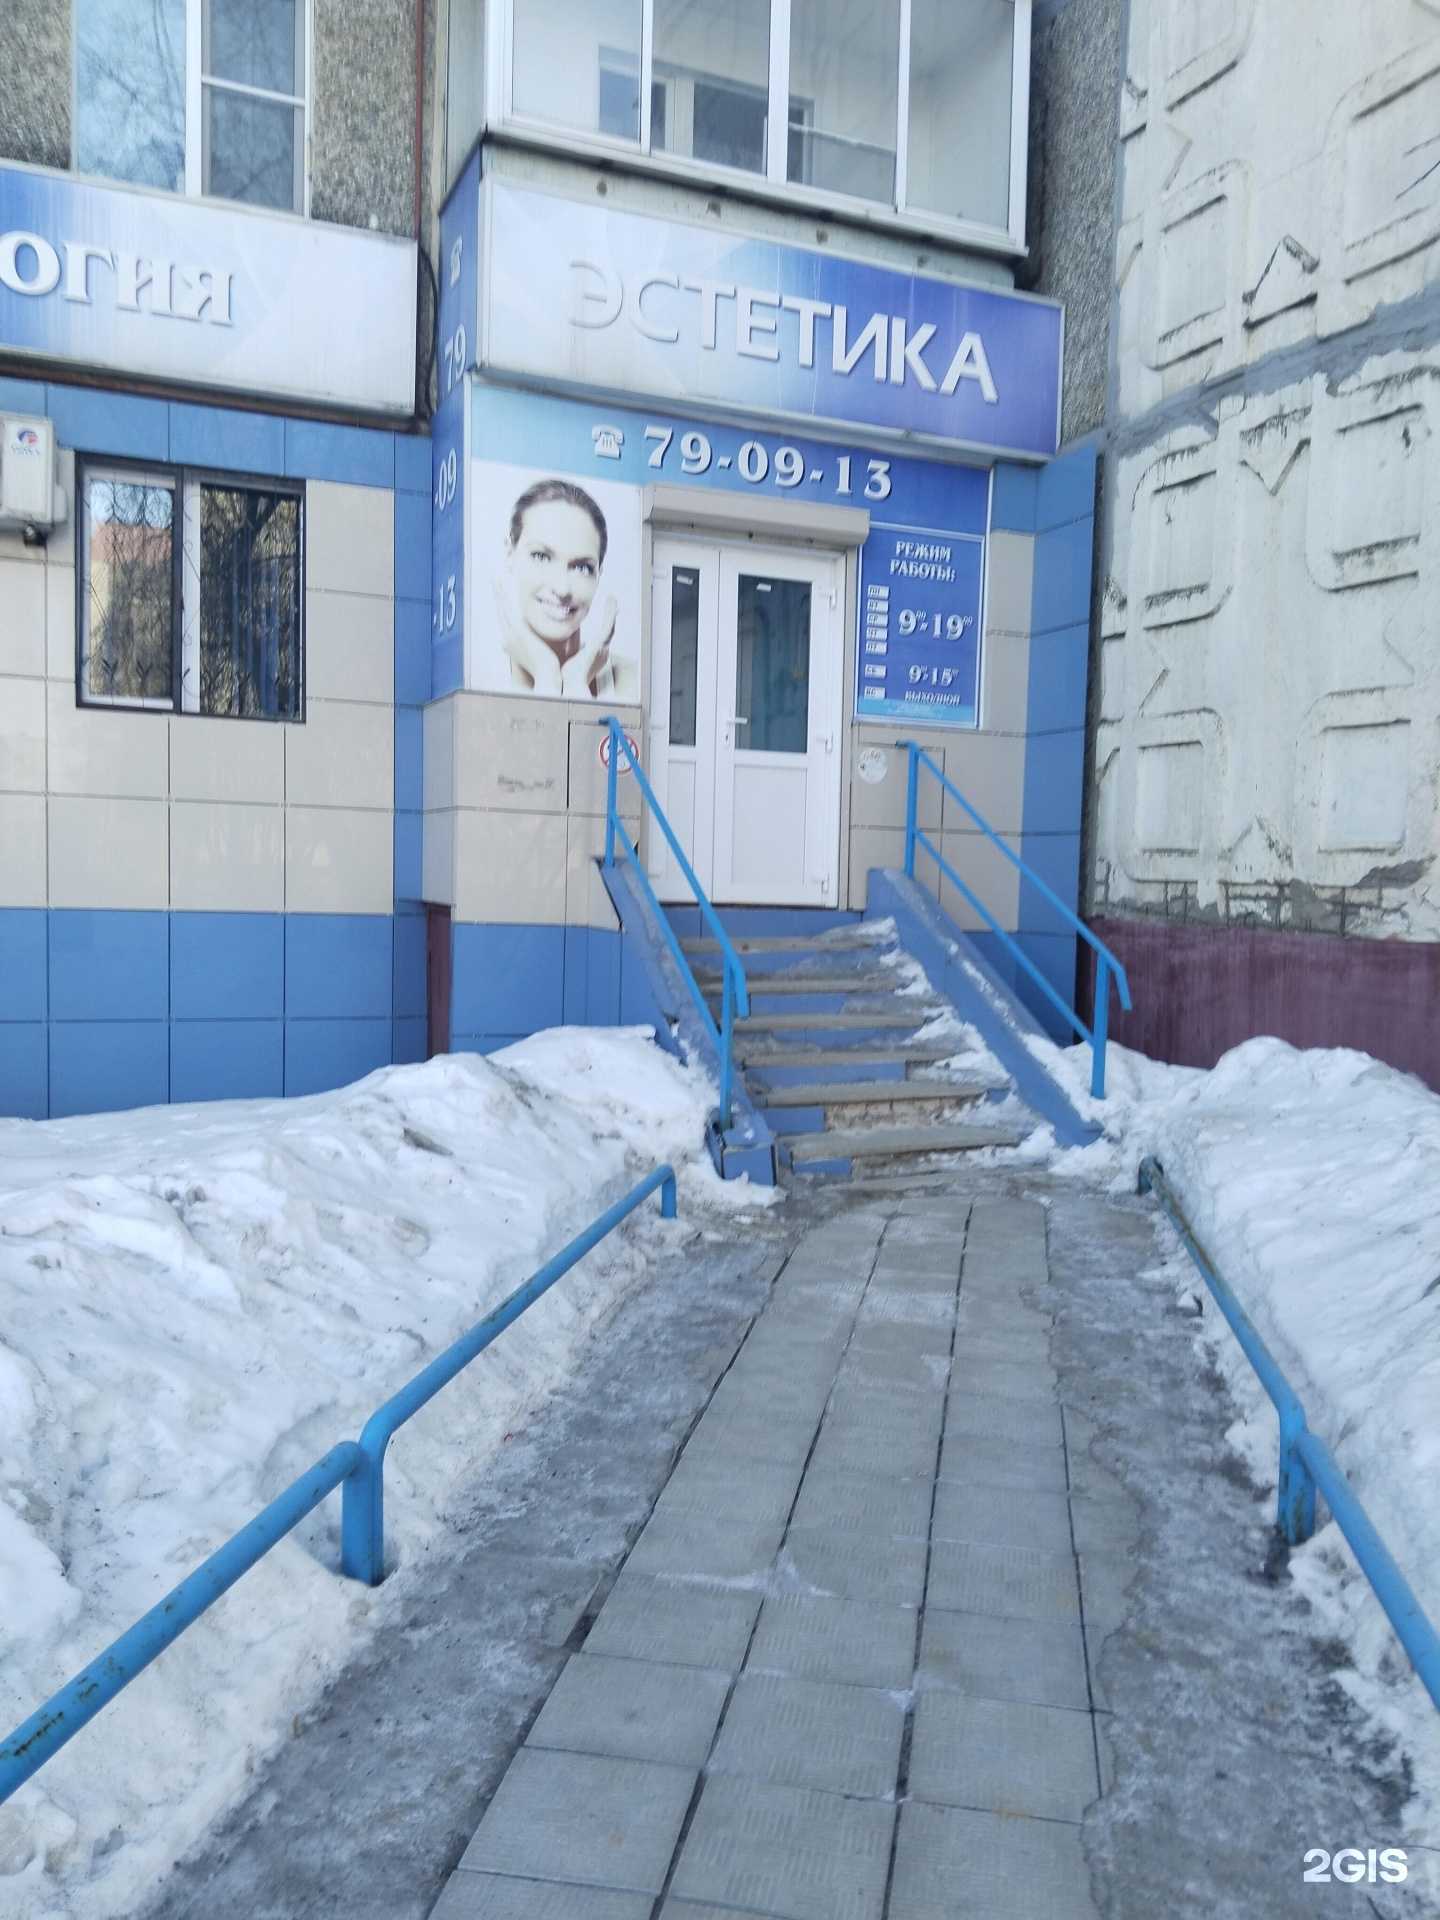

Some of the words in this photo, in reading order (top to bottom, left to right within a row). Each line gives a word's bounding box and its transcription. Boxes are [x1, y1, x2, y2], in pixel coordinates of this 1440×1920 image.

[444, 323, 467, 395] 79
[568, 258, 999, 405] ЭСТЕТИКА
[642, 424, 893, 502] 79-09-13
[889, 558, 957, 583] РАБОТЫ:
[895, 540, 952, 563] РЕЖИМ
